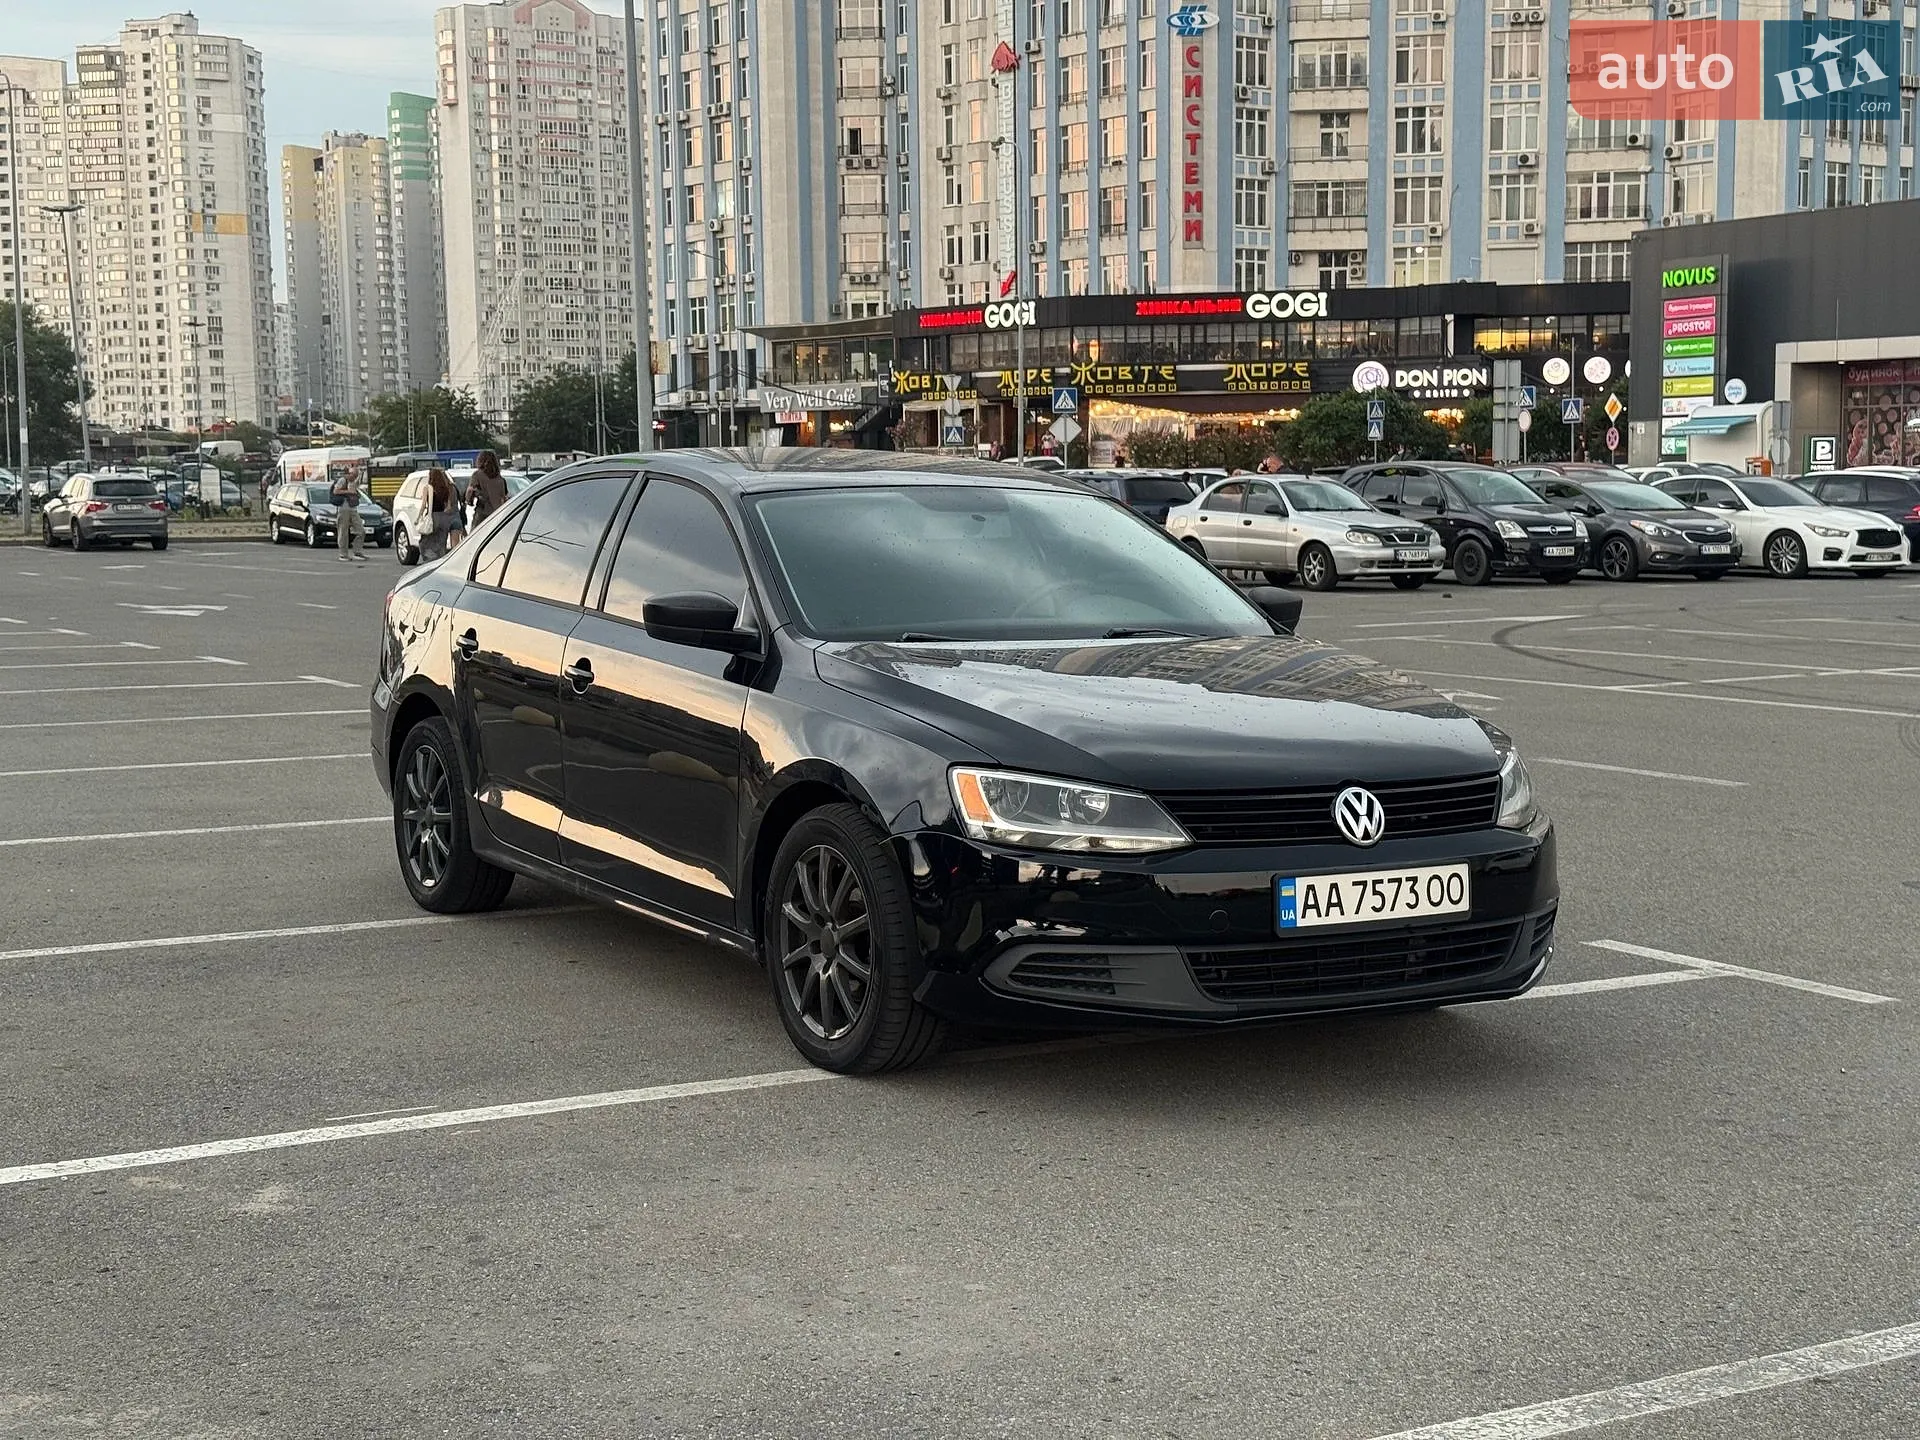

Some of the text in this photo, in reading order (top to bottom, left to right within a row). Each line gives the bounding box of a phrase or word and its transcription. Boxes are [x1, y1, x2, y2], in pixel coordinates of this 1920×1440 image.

[1184, 45, 1203, 242] СИСТЕМИ
[1662, 266, 1715, 288] NOVUS
[985, 301, 1036, 328] GOGI
[1246, 292, 1327, 318] GOGI
[894, 370, 944, 394] ЖОВТ
[1070, 362, 1309, 385] ЖОВТЕ МОРЕ
[1395, 367, 1487, 387] DON PION
[765, 388, 856, 412] Very Well Café
[1301, 882, 1344, 919] AA
[1352, 876, 1419, 914] 7573
[1281, 910, 1295, 920] UA
